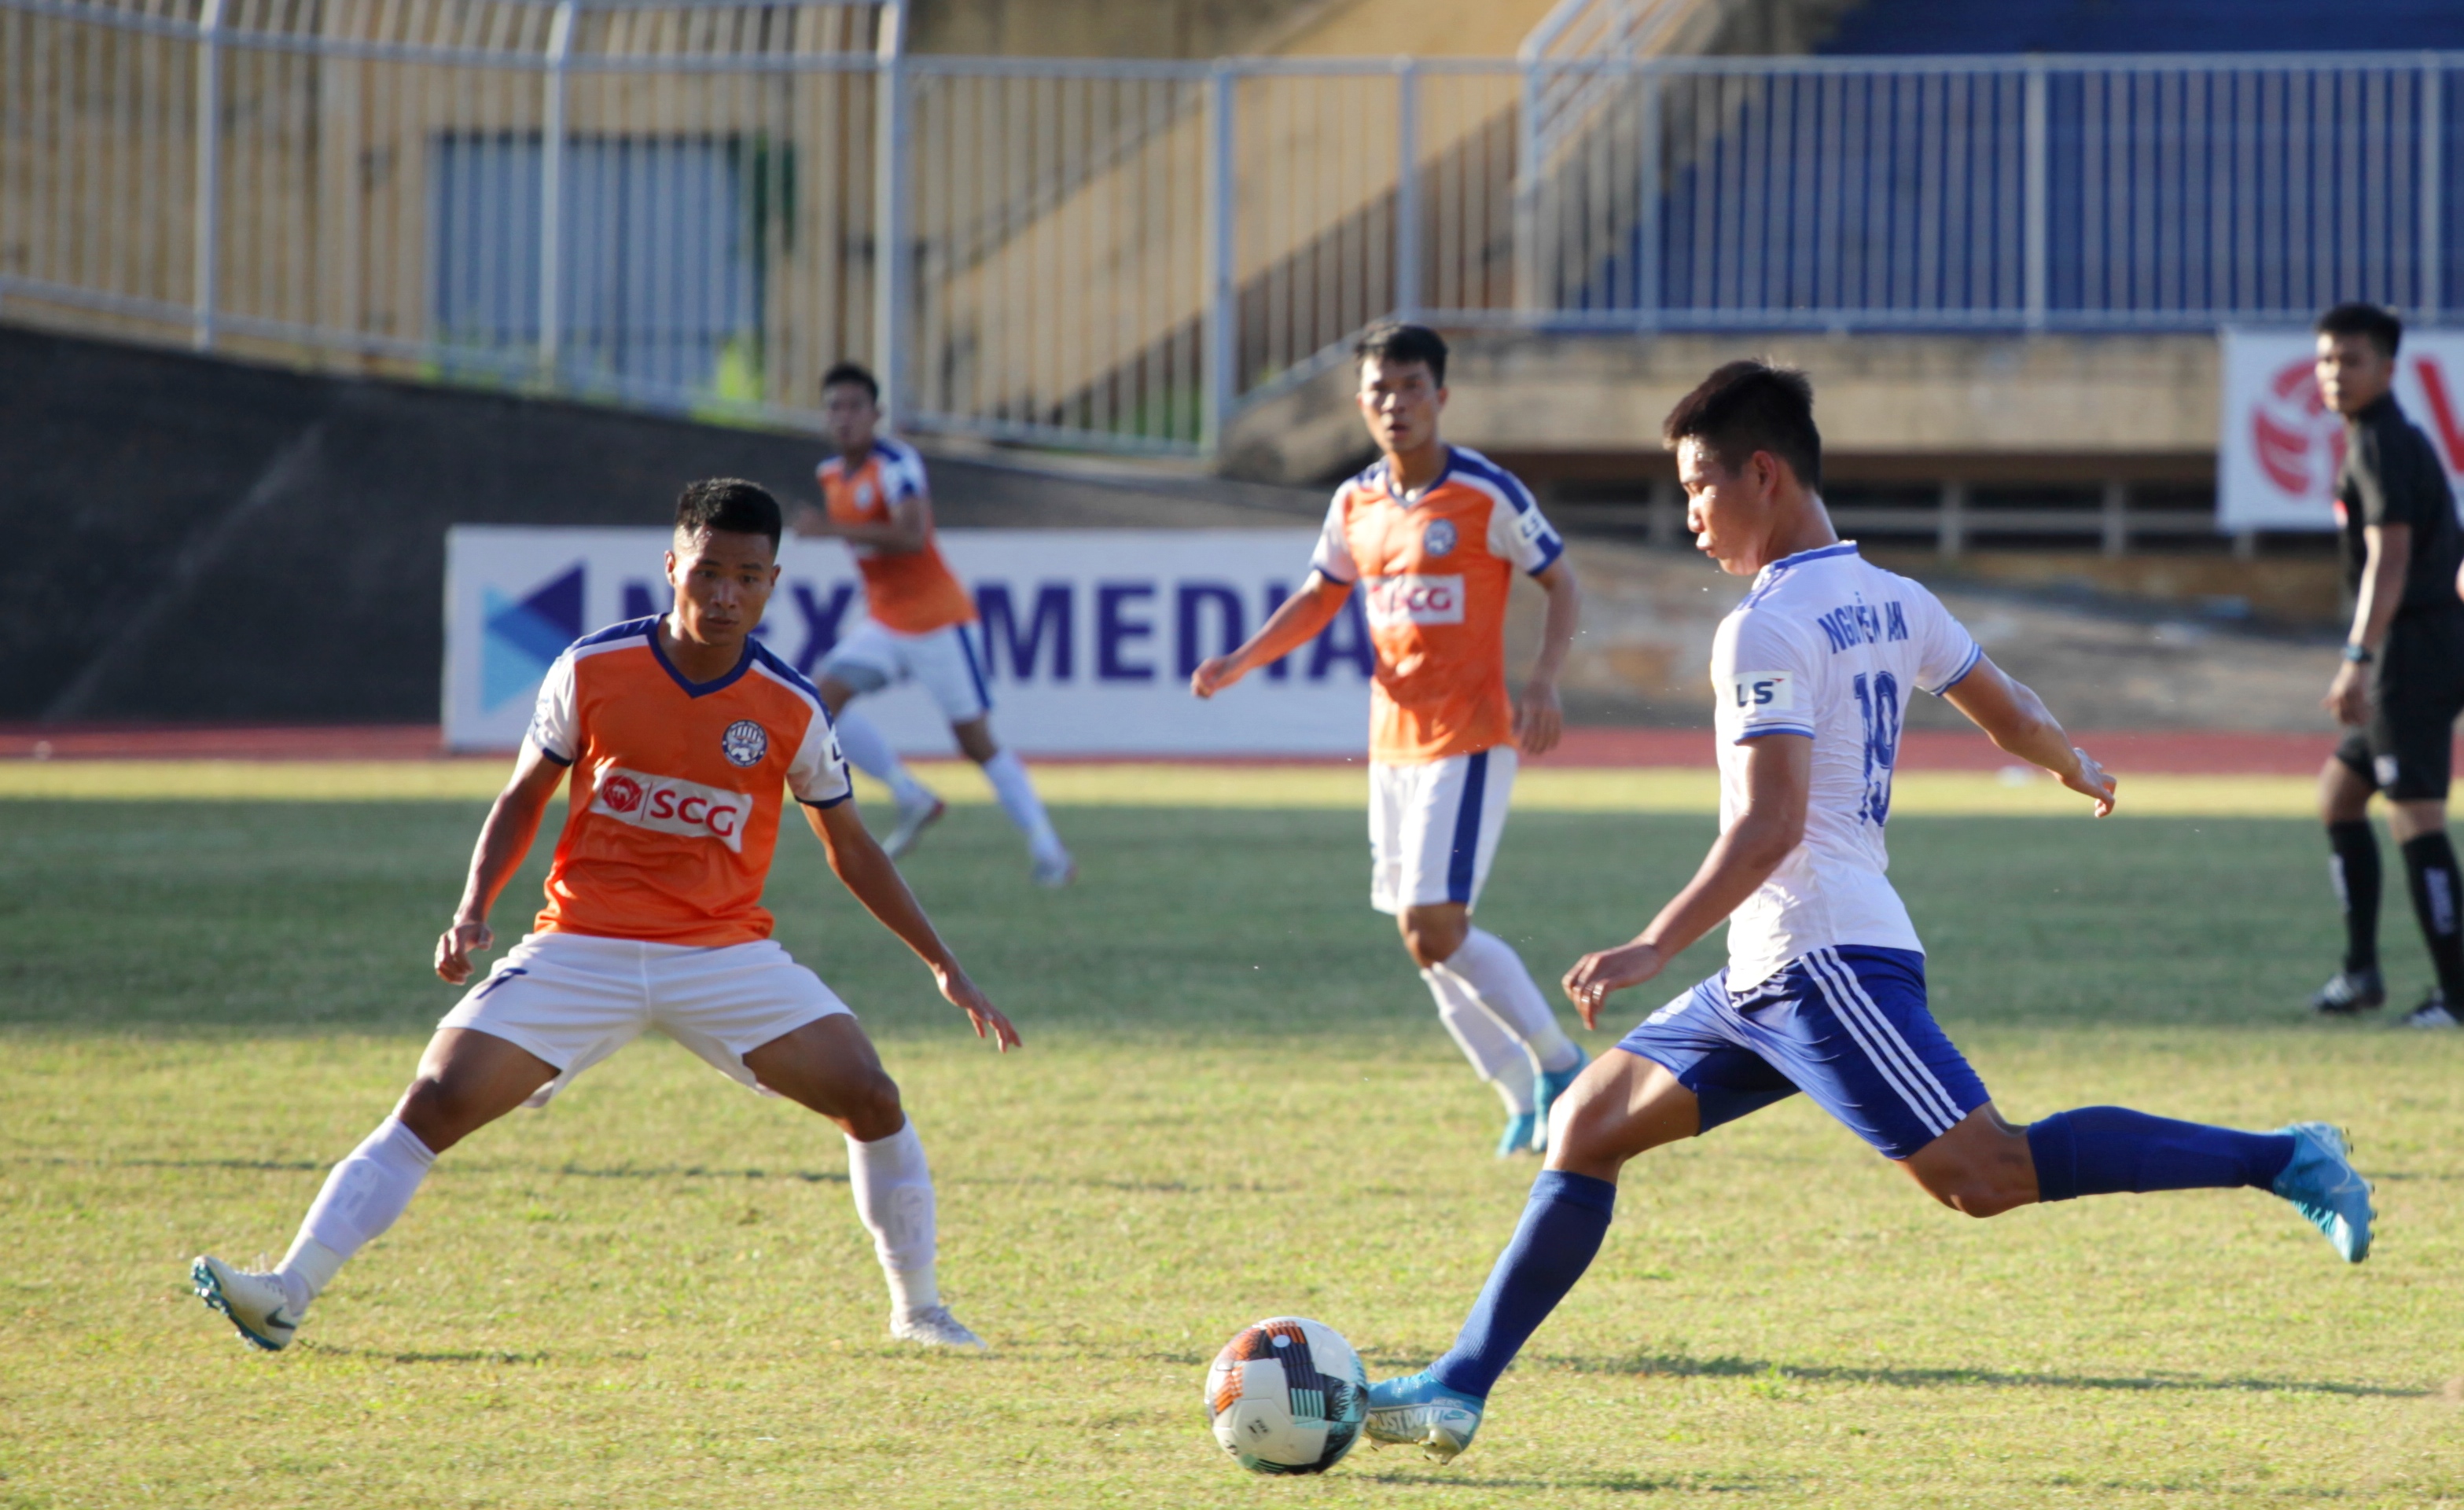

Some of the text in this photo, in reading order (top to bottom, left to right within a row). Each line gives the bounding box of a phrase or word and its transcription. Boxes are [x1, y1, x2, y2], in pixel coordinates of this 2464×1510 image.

[1394, 586, 1453, 612] CG
[1735, 680, 1774, 708] LS
[649, 788, 738, 837] SCG
